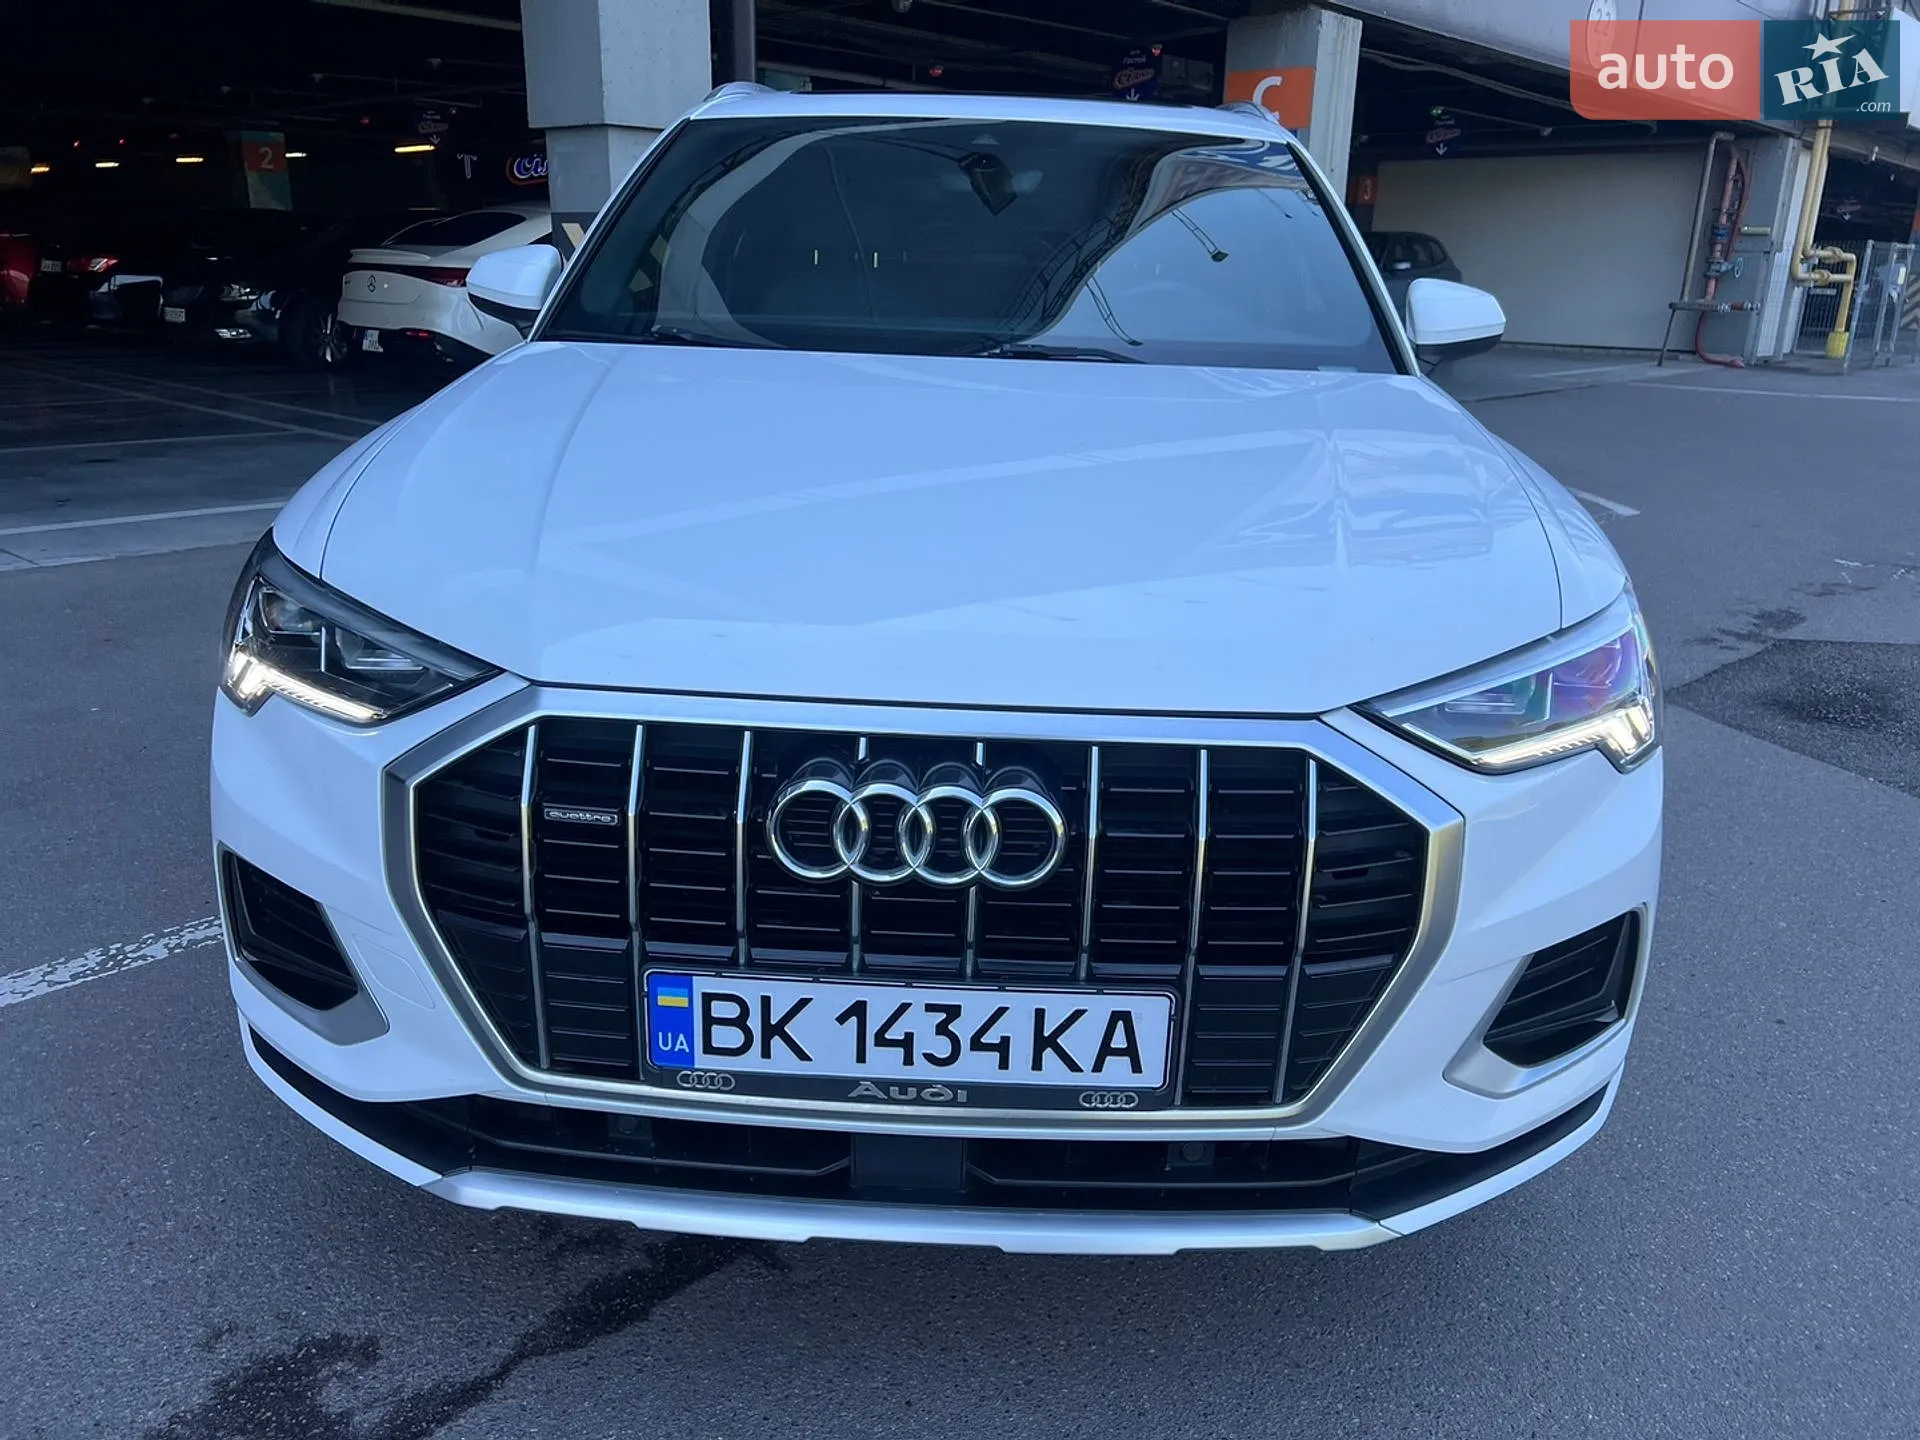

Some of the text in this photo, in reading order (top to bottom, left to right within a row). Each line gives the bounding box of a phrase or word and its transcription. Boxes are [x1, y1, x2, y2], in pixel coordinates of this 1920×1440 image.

[260, 147, 274, 170] 2
[549, 811, 611, 822] quattro
[658, 1031, 690, 1054] UA
[701, 991, 1143, 1074] BK 1434 KA
[848, 1081, 967, 1103] Audi
